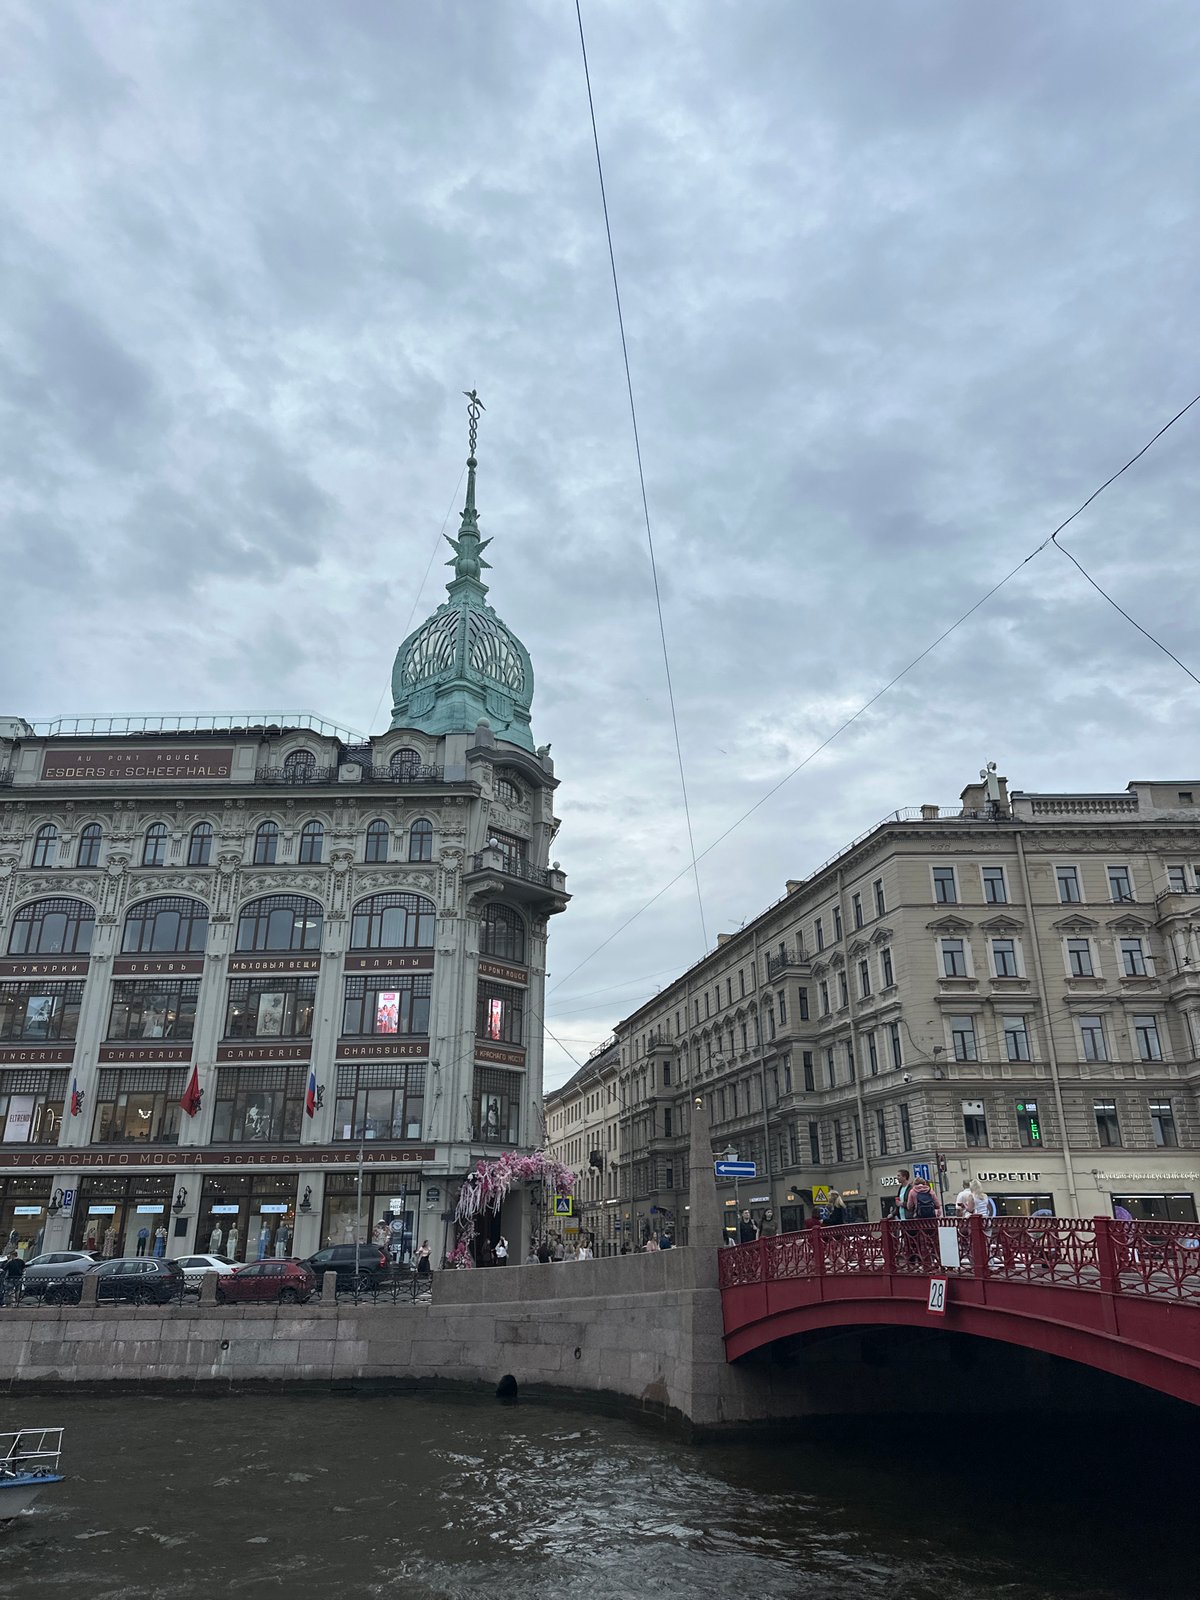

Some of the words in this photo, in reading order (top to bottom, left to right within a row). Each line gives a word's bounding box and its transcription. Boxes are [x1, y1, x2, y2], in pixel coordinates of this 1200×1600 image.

[45, 768, 106, 778] ESDERS
[109, 769, 120, 777] ET
[124, 766, 228, 777] SCHEEFHALS
[289, 960, 317, 968] ВЕЩИ
[360, 959, 419, 967] ШЛЯПЫ
[12, 965, 78, 973] ТУЖУРКИ
[488, 966, 504, 975] PONT
[506, 971, 526, 981] ROUGE
[108, 1051, 184, 1059] CHAPEAUX
[344, 1046, 422, 1055] CHAUSSURES
[12, 1155, 21, 1164] У
[31, 1154, 129, 1165] КРАСНАГО
[139, 1153, 203, 1164] МОСТА
[223, 1155, 303, 1164] ЭСДЕРСЪ
[977, 1172, 1041, 1182] UPPETIT
[931, 1282, 944, 1308] 28
